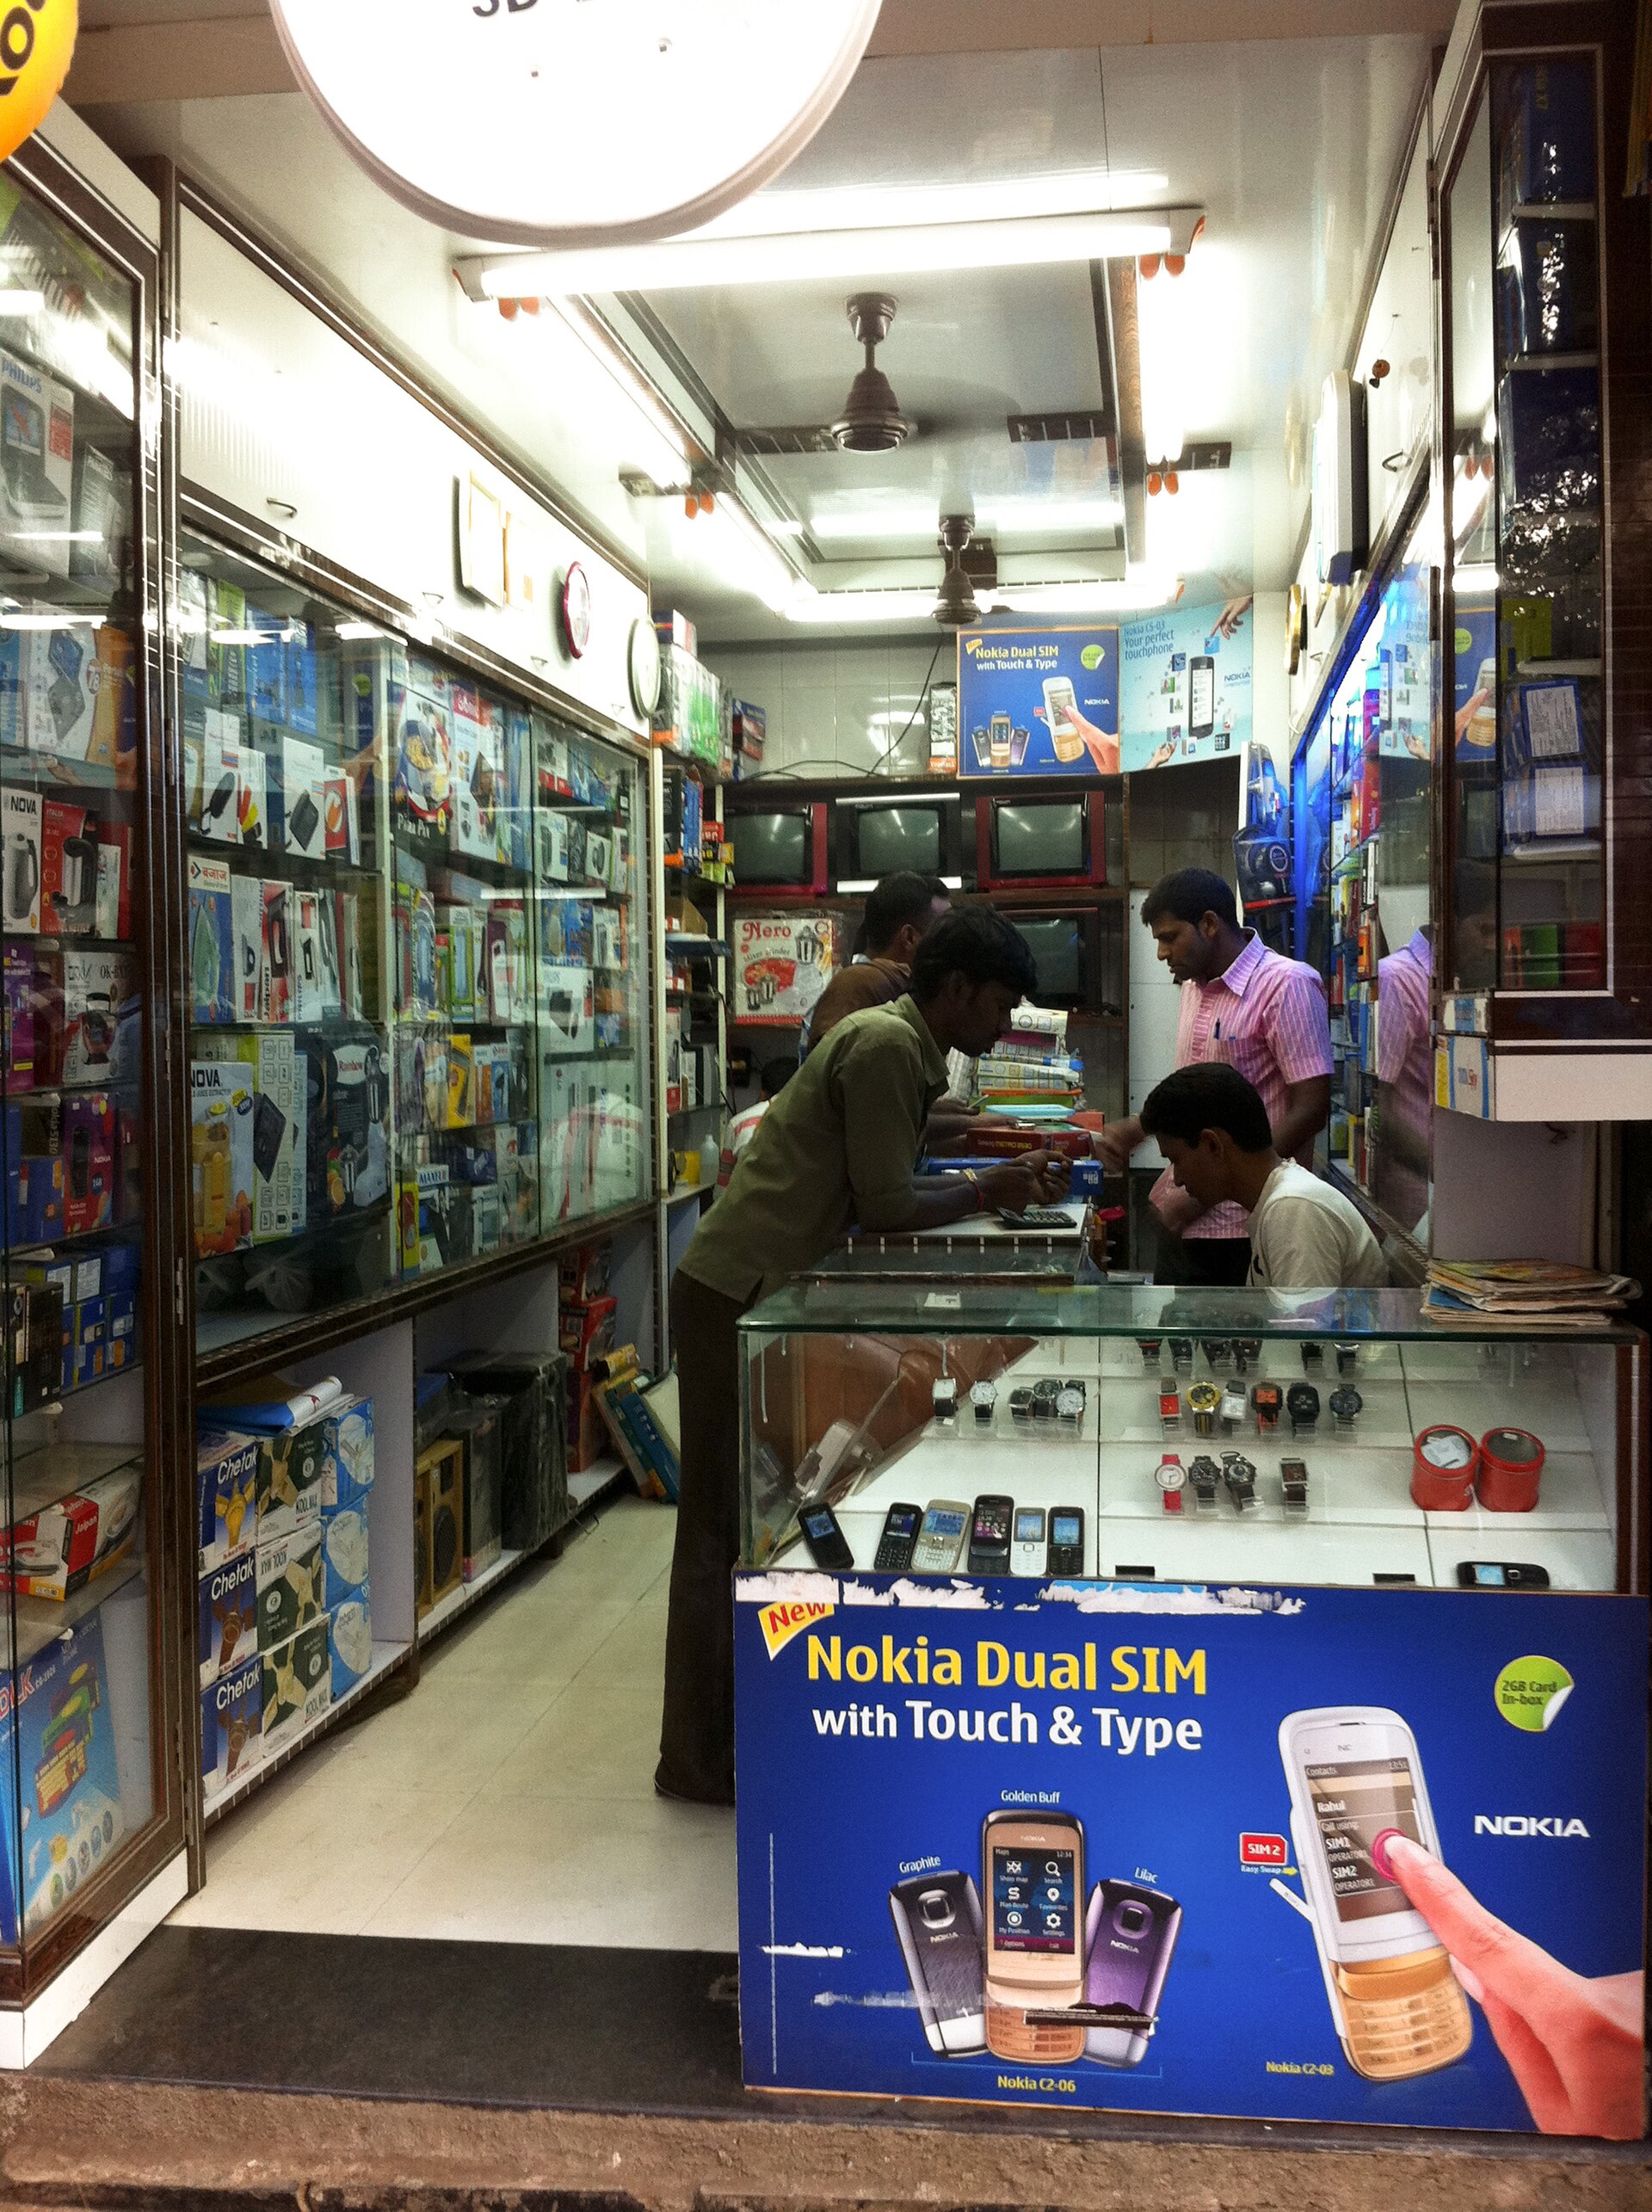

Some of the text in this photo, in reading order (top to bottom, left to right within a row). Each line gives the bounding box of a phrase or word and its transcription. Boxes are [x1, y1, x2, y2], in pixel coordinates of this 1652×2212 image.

[2, 358, 42, 394] PHILIPS
[1124, 625, 1144, 637] Nokia
[1125, 629, 1174, 648] Your perfect
[976, 645, 1059, 659] Nokia Dual SIM
[1125, 643, 1174, 661] touchphone
[977, 659, 1057, 671] with Touch & Type
[1224, 671, 1251, 681] NOKIA
[10, 796, 37, 815] NOVA
[743, 921, 792, 942] Nero
[218, 1445, 257, 1485] Chetak
[75, 1516, 98, 1535] Jaipan
[211, 1556, 254, 1600] Chetak
[768, 1603, 827, 1634] New
[807, 1635, 1206, 1695] Nokia Dual SIM
[217, 1664, 261, 1710] Chetak
[812, 1700, 1202, 1756] with Touch & Type
[1306, 1765, 1337, 1777] Contacts
[1001, 1790, 1060, 1804] Golden Buff
[1317, 1800, 1346, 1812] Rahul
[1474, 1815, 1591, 1839] NOKIA
[1248, 1843, 1281, 1857] SIM 2
[899, 1855, 941, 1874] Graphite
[1241, 1864, 1282, 1875] Easy Swap
[1333, 1865, 1358, 1878] SIM2
[1134, 1867, 1157, 1884] Lilac
[929, 1931, 960, 1944] NOKIA
[1110, 1939, 1140, 1954] NOKIA
[1266, 2060, 1334, 2077] Nokia C2-03
[997, 2075, 1076, 2092] Nokia C2-06
